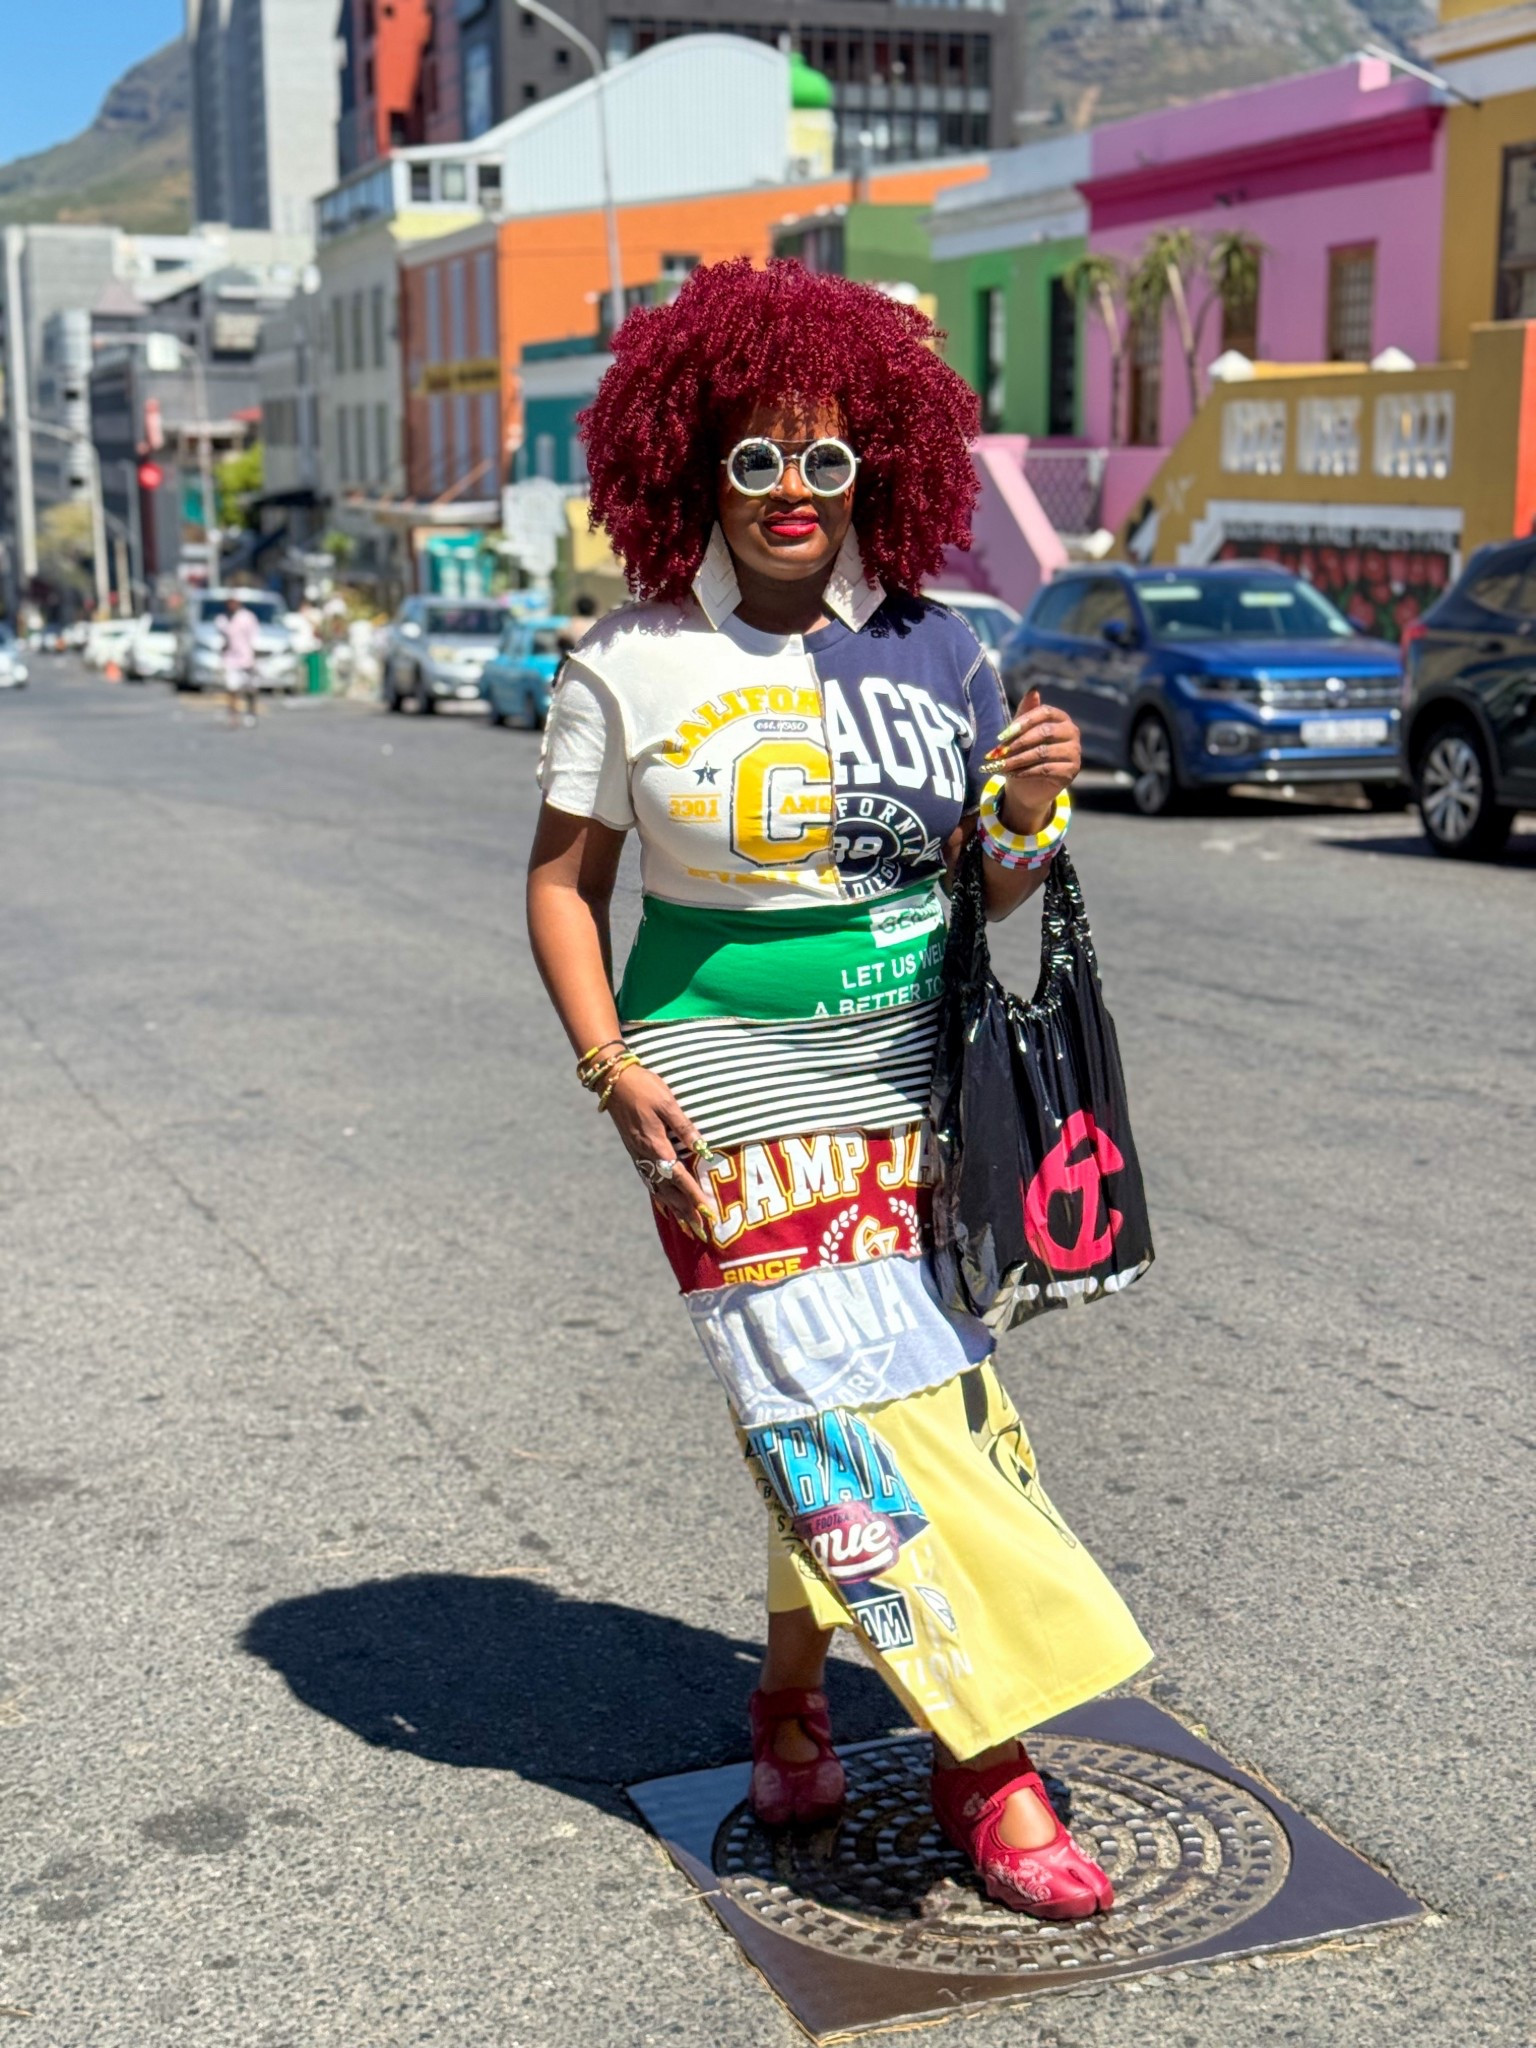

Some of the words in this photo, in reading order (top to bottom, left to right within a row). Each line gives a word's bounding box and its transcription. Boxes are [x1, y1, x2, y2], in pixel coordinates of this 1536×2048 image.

[841, 962, 885, 989] LET
[891, 953, 916, 979] US
[812, 1001, 830, 1018] A
[839, 983, 921, 1015] BETTER
[694, 1127, 869, 1249] CAMP
[723, 1258, 802, 1284] SINCE
